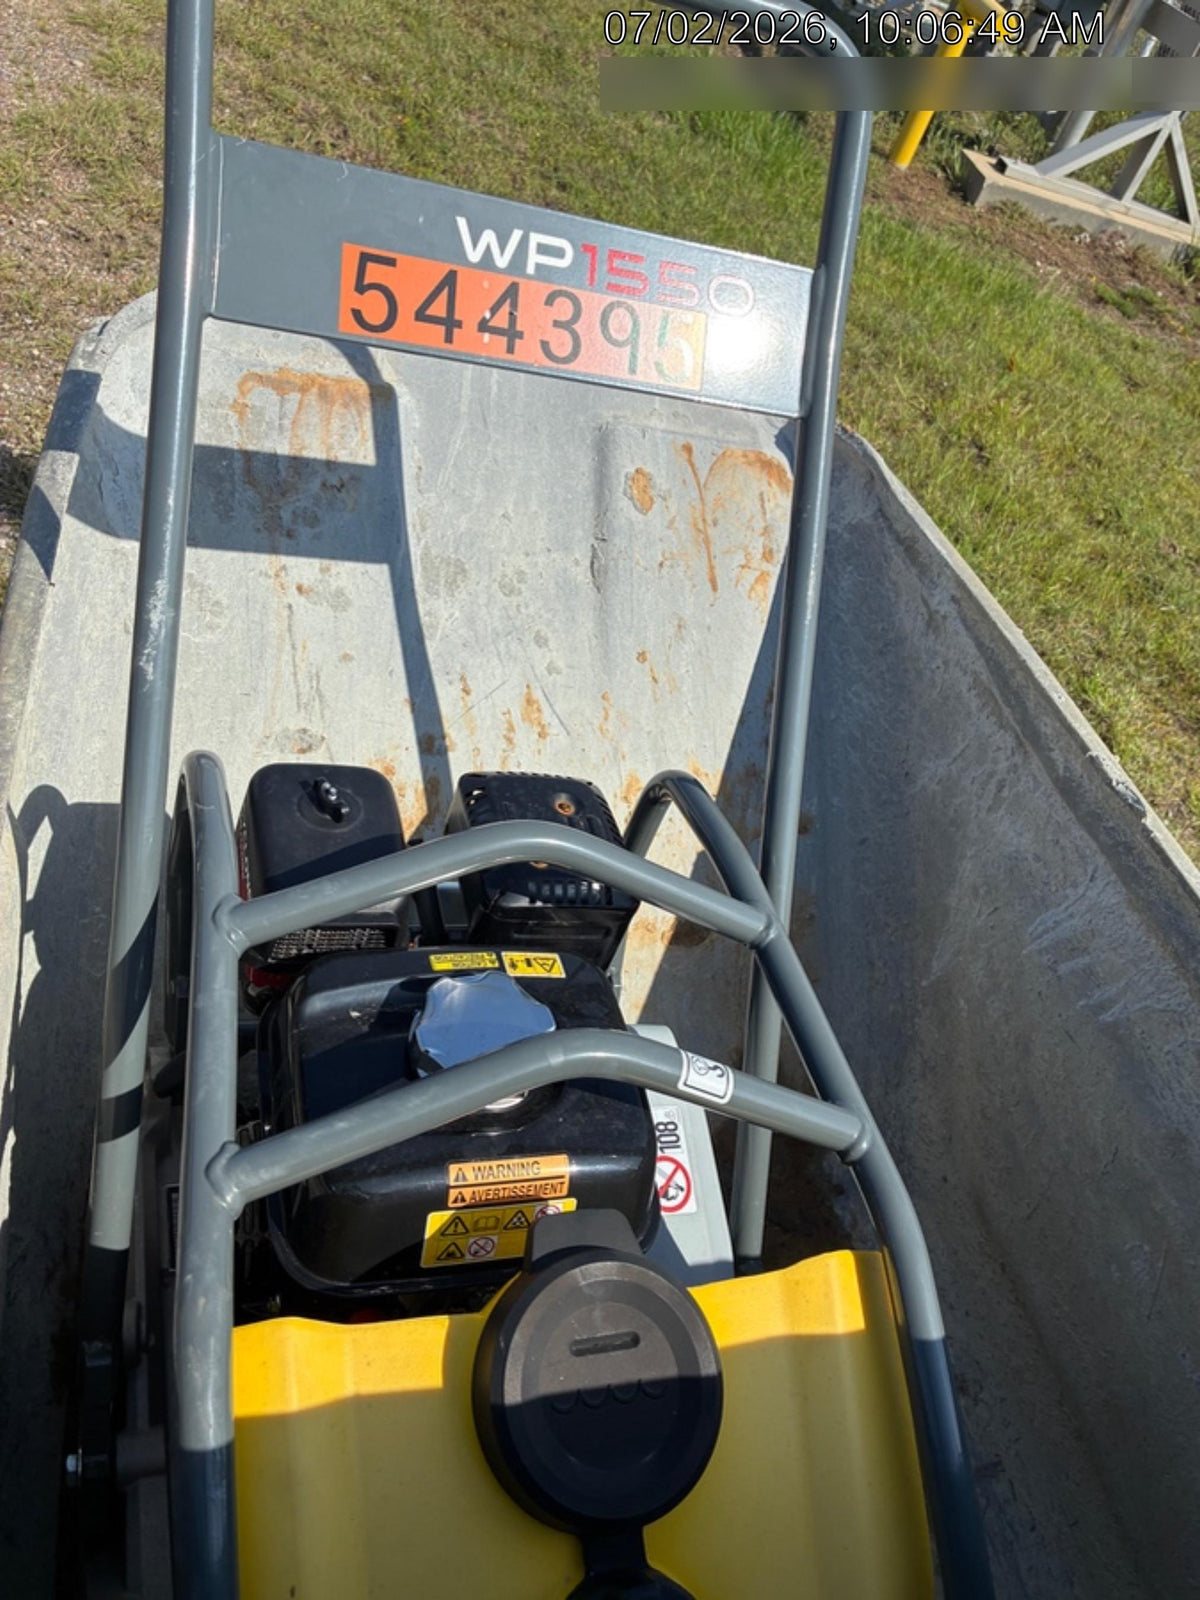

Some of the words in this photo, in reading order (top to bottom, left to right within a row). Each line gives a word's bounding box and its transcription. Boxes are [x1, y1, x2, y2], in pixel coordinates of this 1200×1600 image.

[455, 215, 755, 317] WP1550
[350, 251, 695, 384] 544395
[655, 1121, 682, 1154] 108
[472, 1160, 541, 1180] WARNING
[469, 1182, 566, 1202] AVERTISSEMENT
